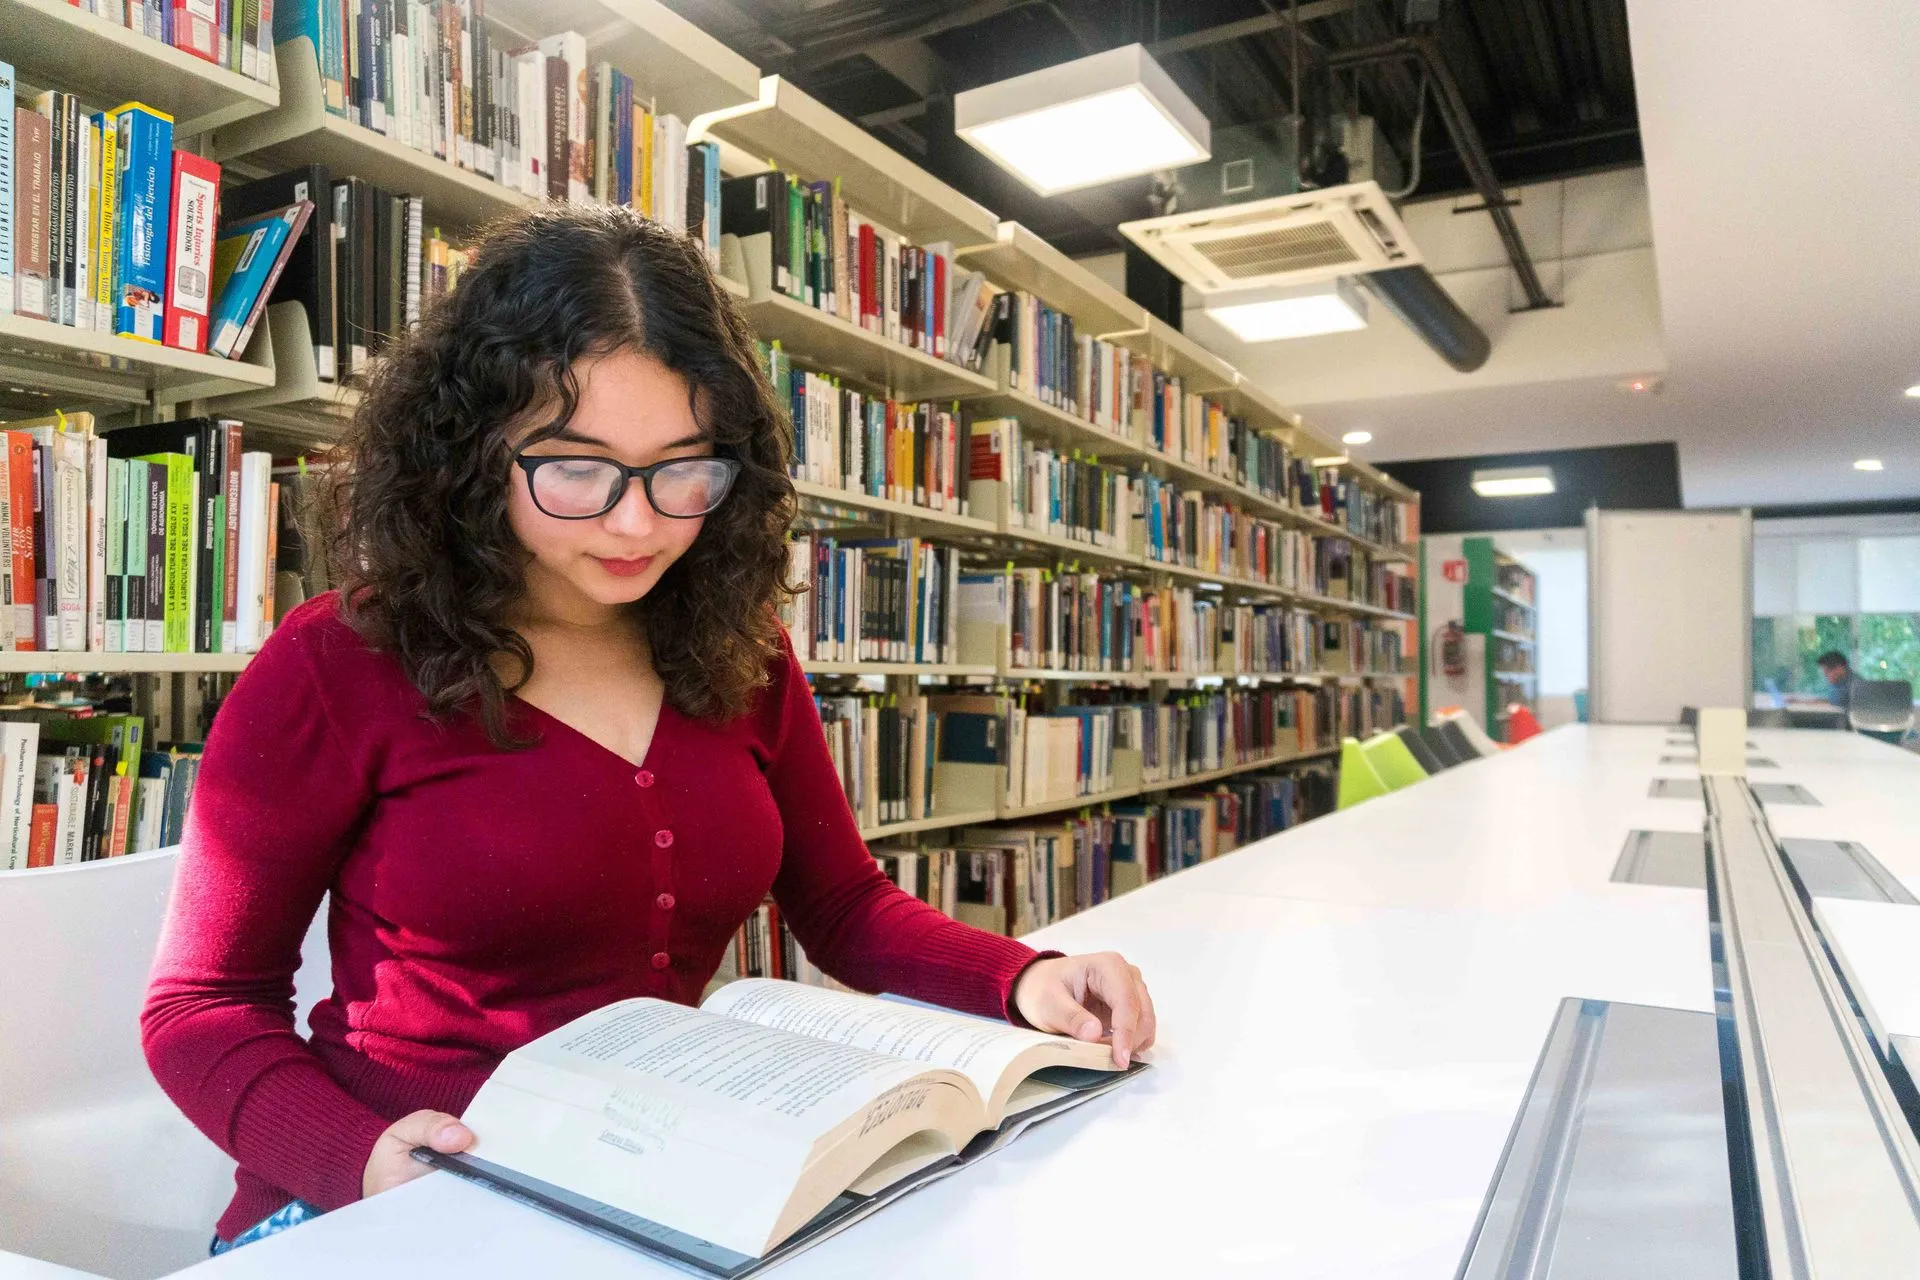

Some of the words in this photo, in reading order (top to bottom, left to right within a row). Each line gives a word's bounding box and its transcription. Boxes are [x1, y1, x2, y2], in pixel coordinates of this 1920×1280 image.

[104, 134, 116, 164] Sports
[32, 152, 42, 190] TRABAJO
[104, 167, 115, 205] Medicine
[145, 166, 156, 204] Ejercicio
[33, 193, 41, 203] EL
[52, 172, 61, 210] DEPORTIVO
[67, 174, 76, 211] DEPORTIVO
[32, 204, 41, 216] EN
[51, 210, 60, 235] MASAJE
[103, 211, 114, 234] Bible
[145, 206, 154, 219] del
[196, 192, 206, 223] Sports
[66, 211, 74, 236] MASAJE
[184, 199, 195, 252] SOURCEBOOK
[31, 217, 41, 263] BIENESTAR
[142, 223, 155, 266] Fisiología
[193, 226, 205, 266] Injuries
[151, 481, 159, 510] SELECTOS
[228, 471, 239, 530] BIOTECHNOLOGY
[1, 501, 10, 525] ANIMAL
[170, 517, 178, 537] SIGLO
[181, 518, 190, 537] SIGLO
[2, 527, 12, 568] VOLUNTEERS
[158, 527, 166, 537] DE
[181, 540, 189, 552] DEL
[169, 553, 177, 600] AGRICULTURA
[181, 554, 189, 600] AGRICULTURA
[169, 602, 176, 611] LA
[181, 602, 188, 611] LA
[18, 738, 28, 773] Postharvest
[14, 774, 24, 806] Technology
[11, 815, 20, 854] Horticultural
[64, 831, 75, 861] MARKET
